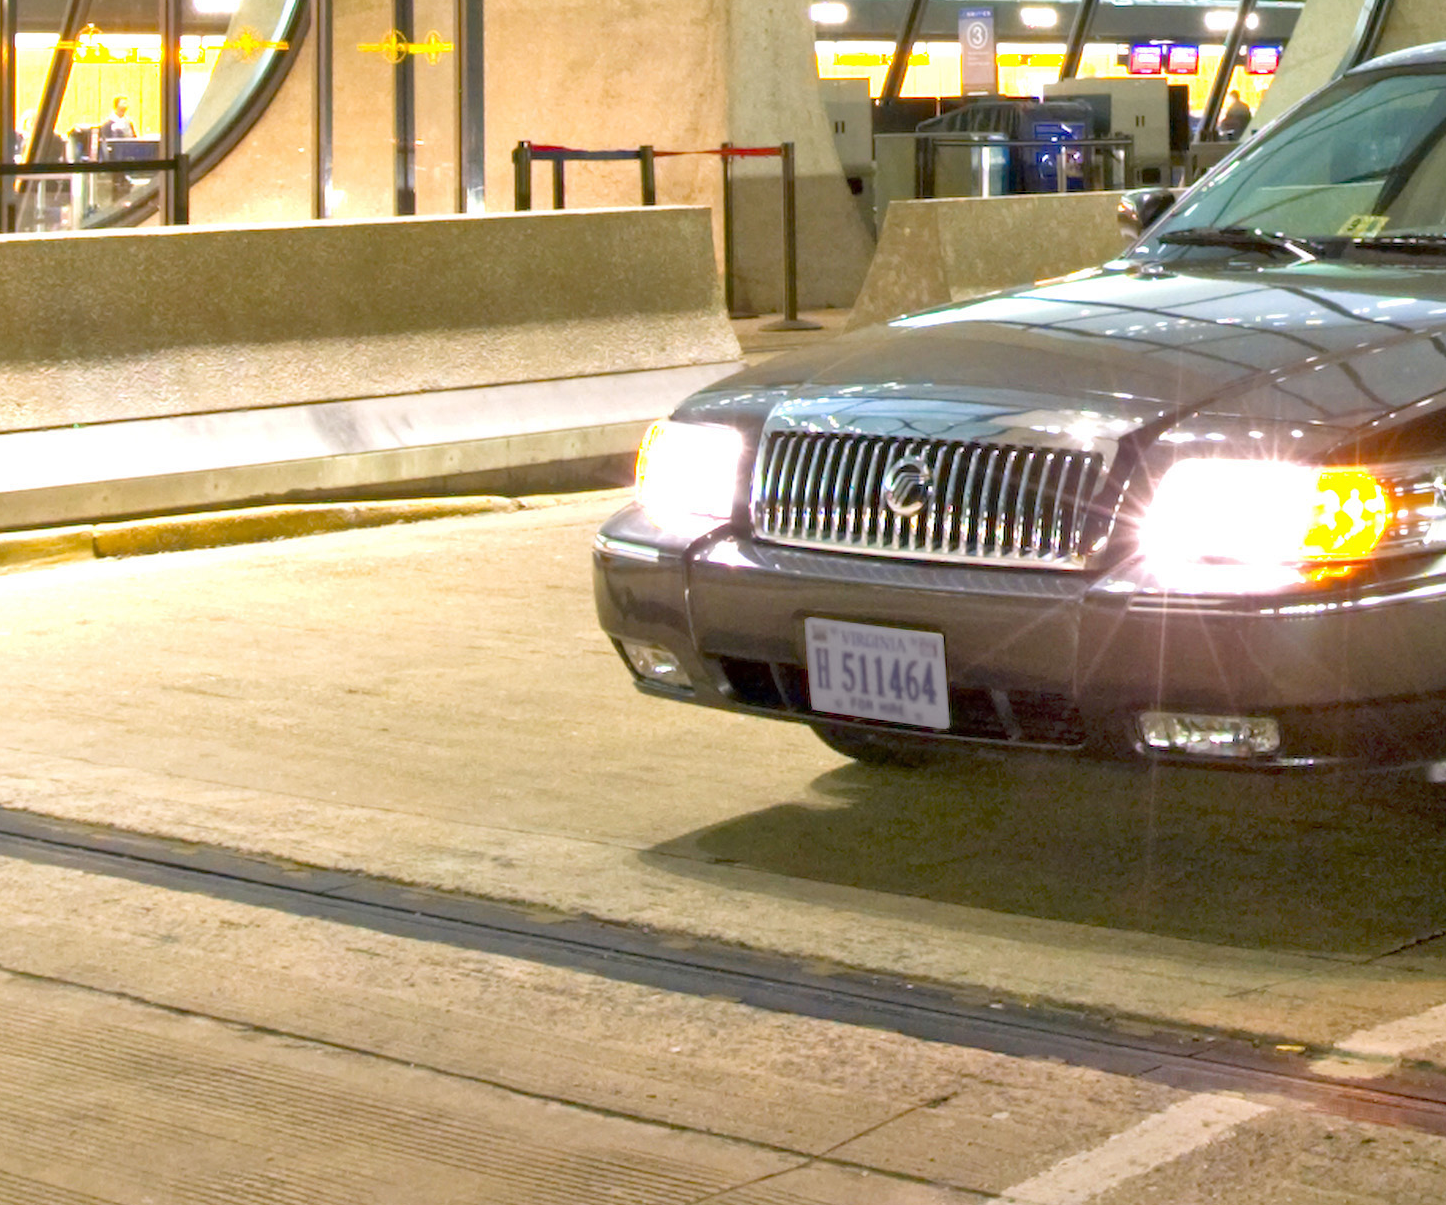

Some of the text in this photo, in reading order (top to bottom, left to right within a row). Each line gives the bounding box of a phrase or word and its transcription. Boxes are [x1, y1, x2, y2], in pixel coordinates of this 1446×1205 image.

[972, 26, 983, 45] 3
[841, 630, 906, 653] VIRGINIA
[841, 651, 938, 705] 511464
